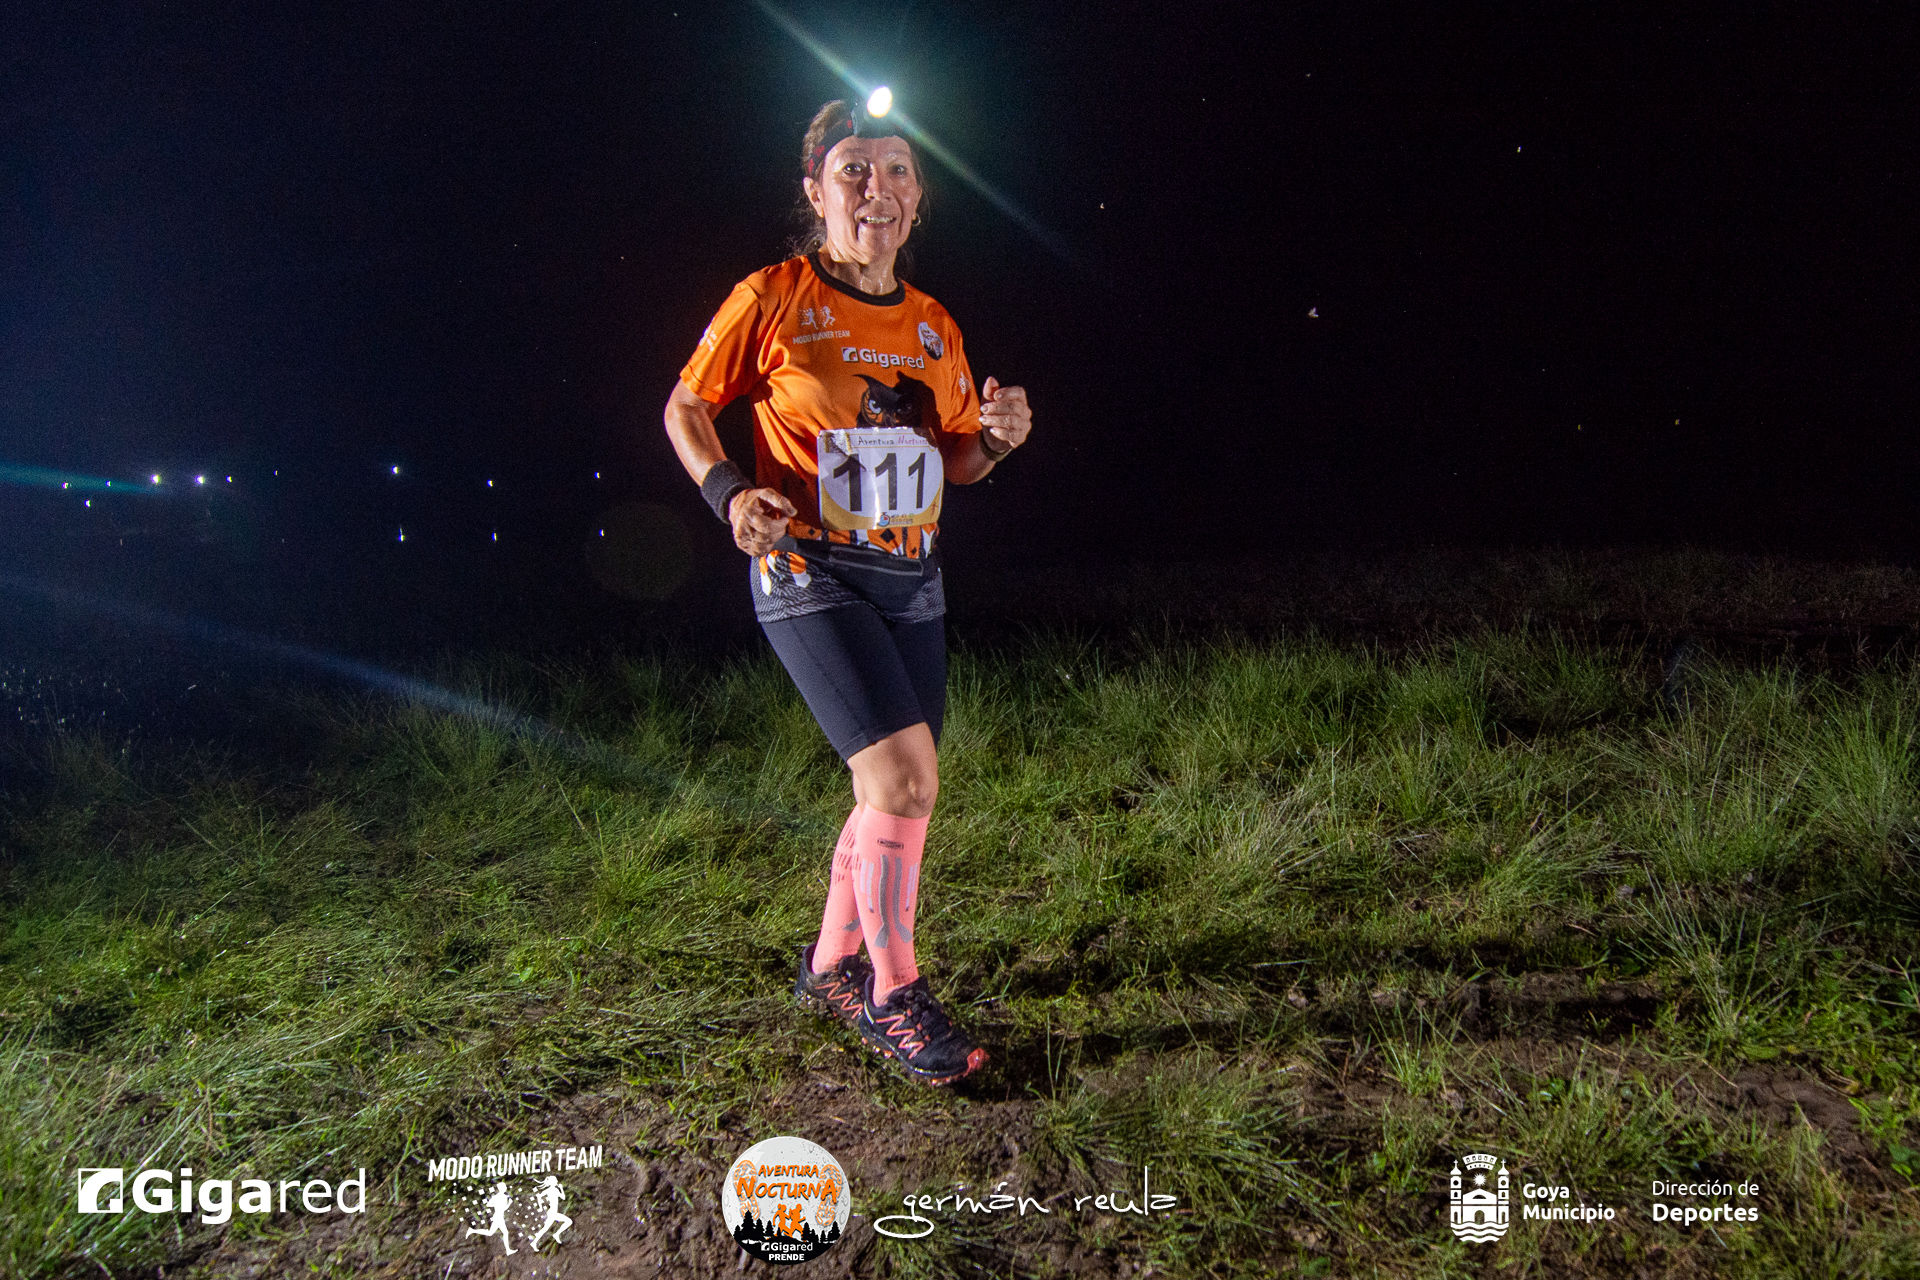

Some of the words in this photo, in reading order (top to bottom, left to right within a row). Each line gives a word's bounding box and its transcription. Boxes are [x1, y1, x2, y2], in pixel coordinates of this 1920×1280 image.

[834, 330, 850, 338] TEAM
[859, 348, 925, 369] Gigared
[858, 436, 894, 445] Aventura
[833, 452, 926, 512] 111
